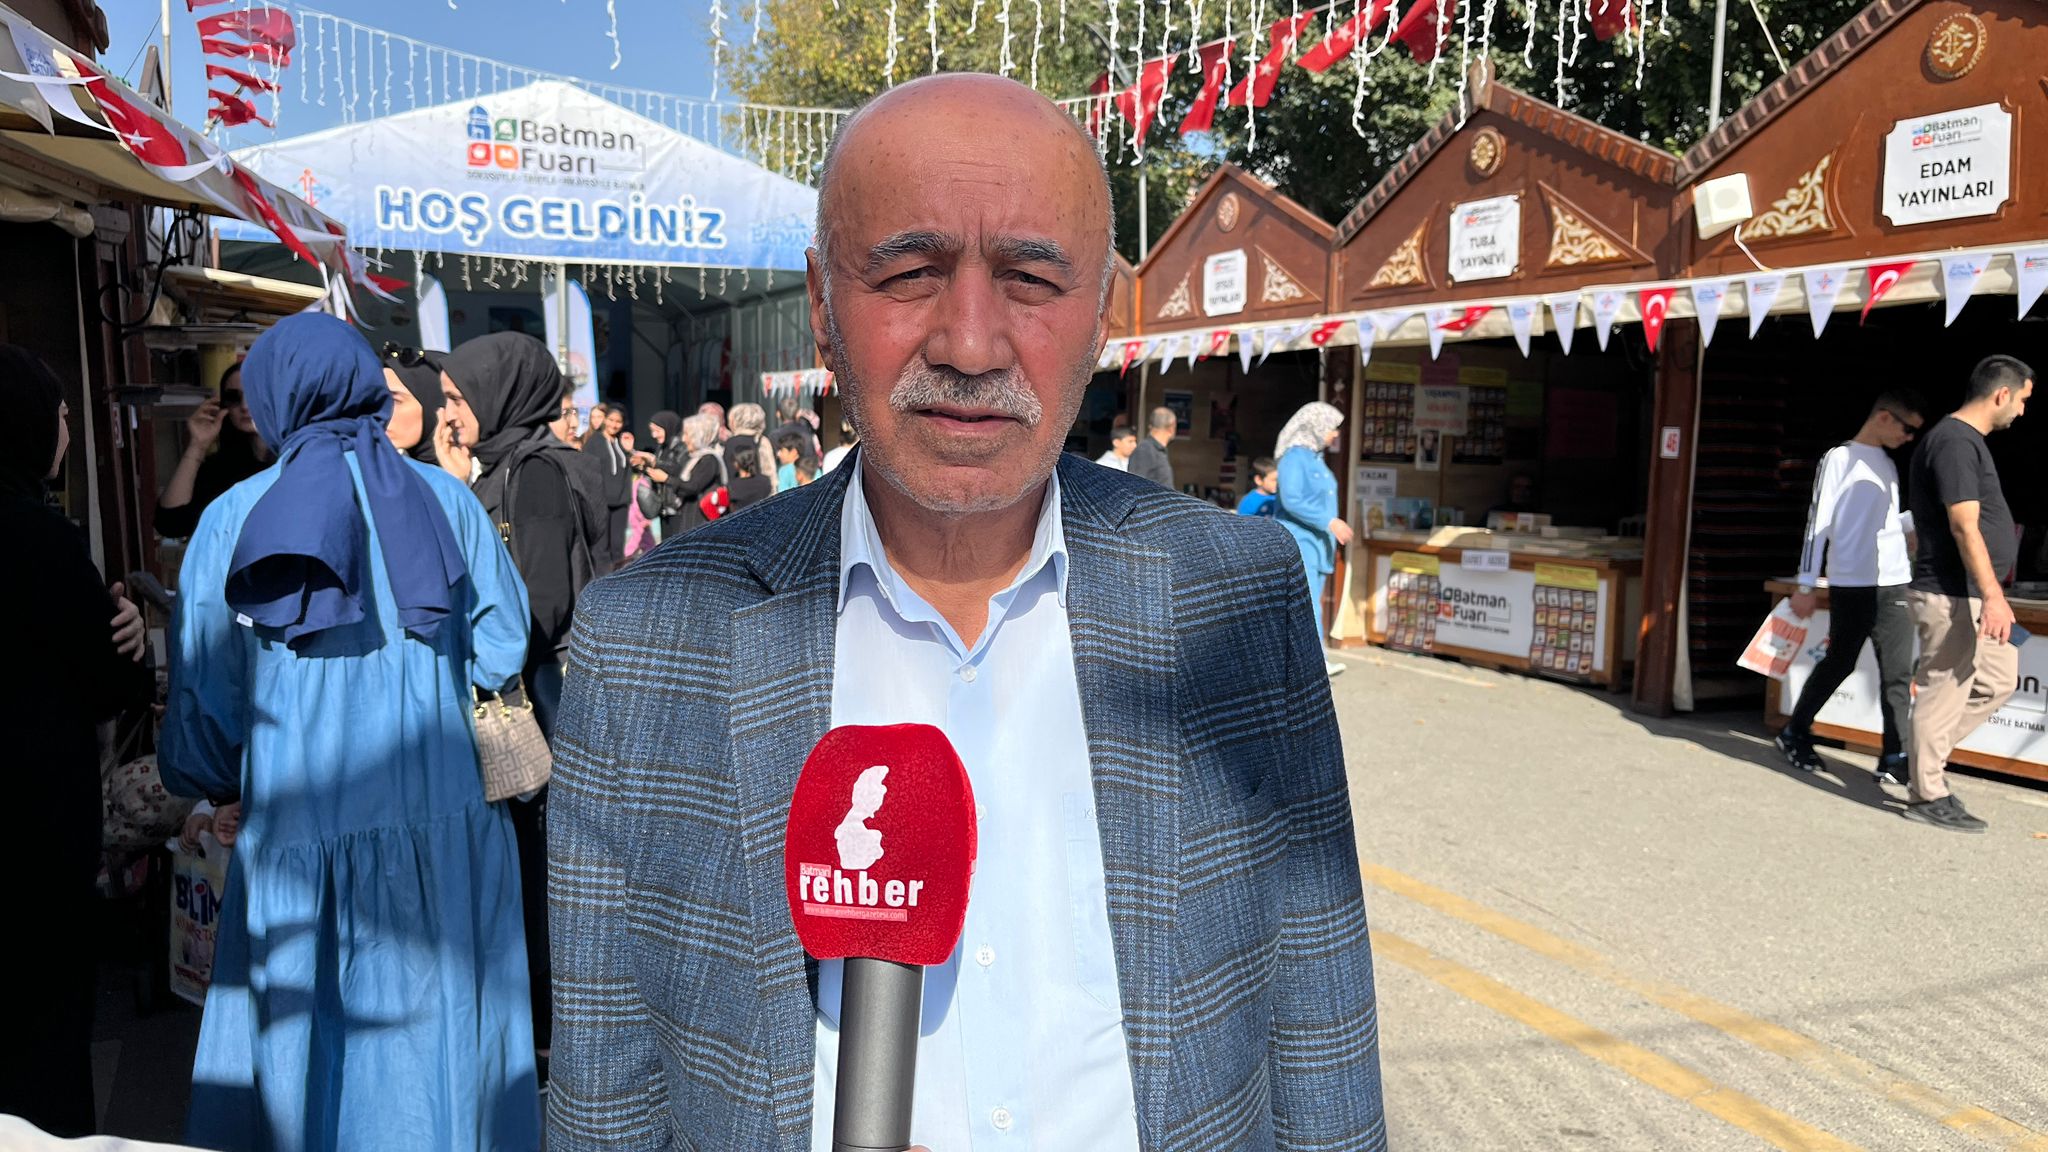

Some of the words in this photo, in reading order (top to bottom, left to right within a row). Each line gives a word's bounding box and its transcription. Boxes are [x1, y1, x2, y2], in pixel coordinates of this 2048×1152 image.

[521, 119, 635, 151] Batman
[1932, 116, 1978, 132] Batman
[521, 148, 596, 175] Fuarı
[1920, 157, 1972, 179] EDAM
[1898, 180, 1993, 208] YAYINLARI
[378, 187, 489, 243] HOŞ
[501, 193, 725, 246] GELDİNİZ
[1470, 234, 1496, 249] TUBA
[1452, 587, 1507, 610] Batman
[1452, 605, 1488, 623] Fuarı
[2014, 720, 2046, 732] BATMAN
[801, 864, 831, 877] Batman
[799, 869, 924, 908] rehber
